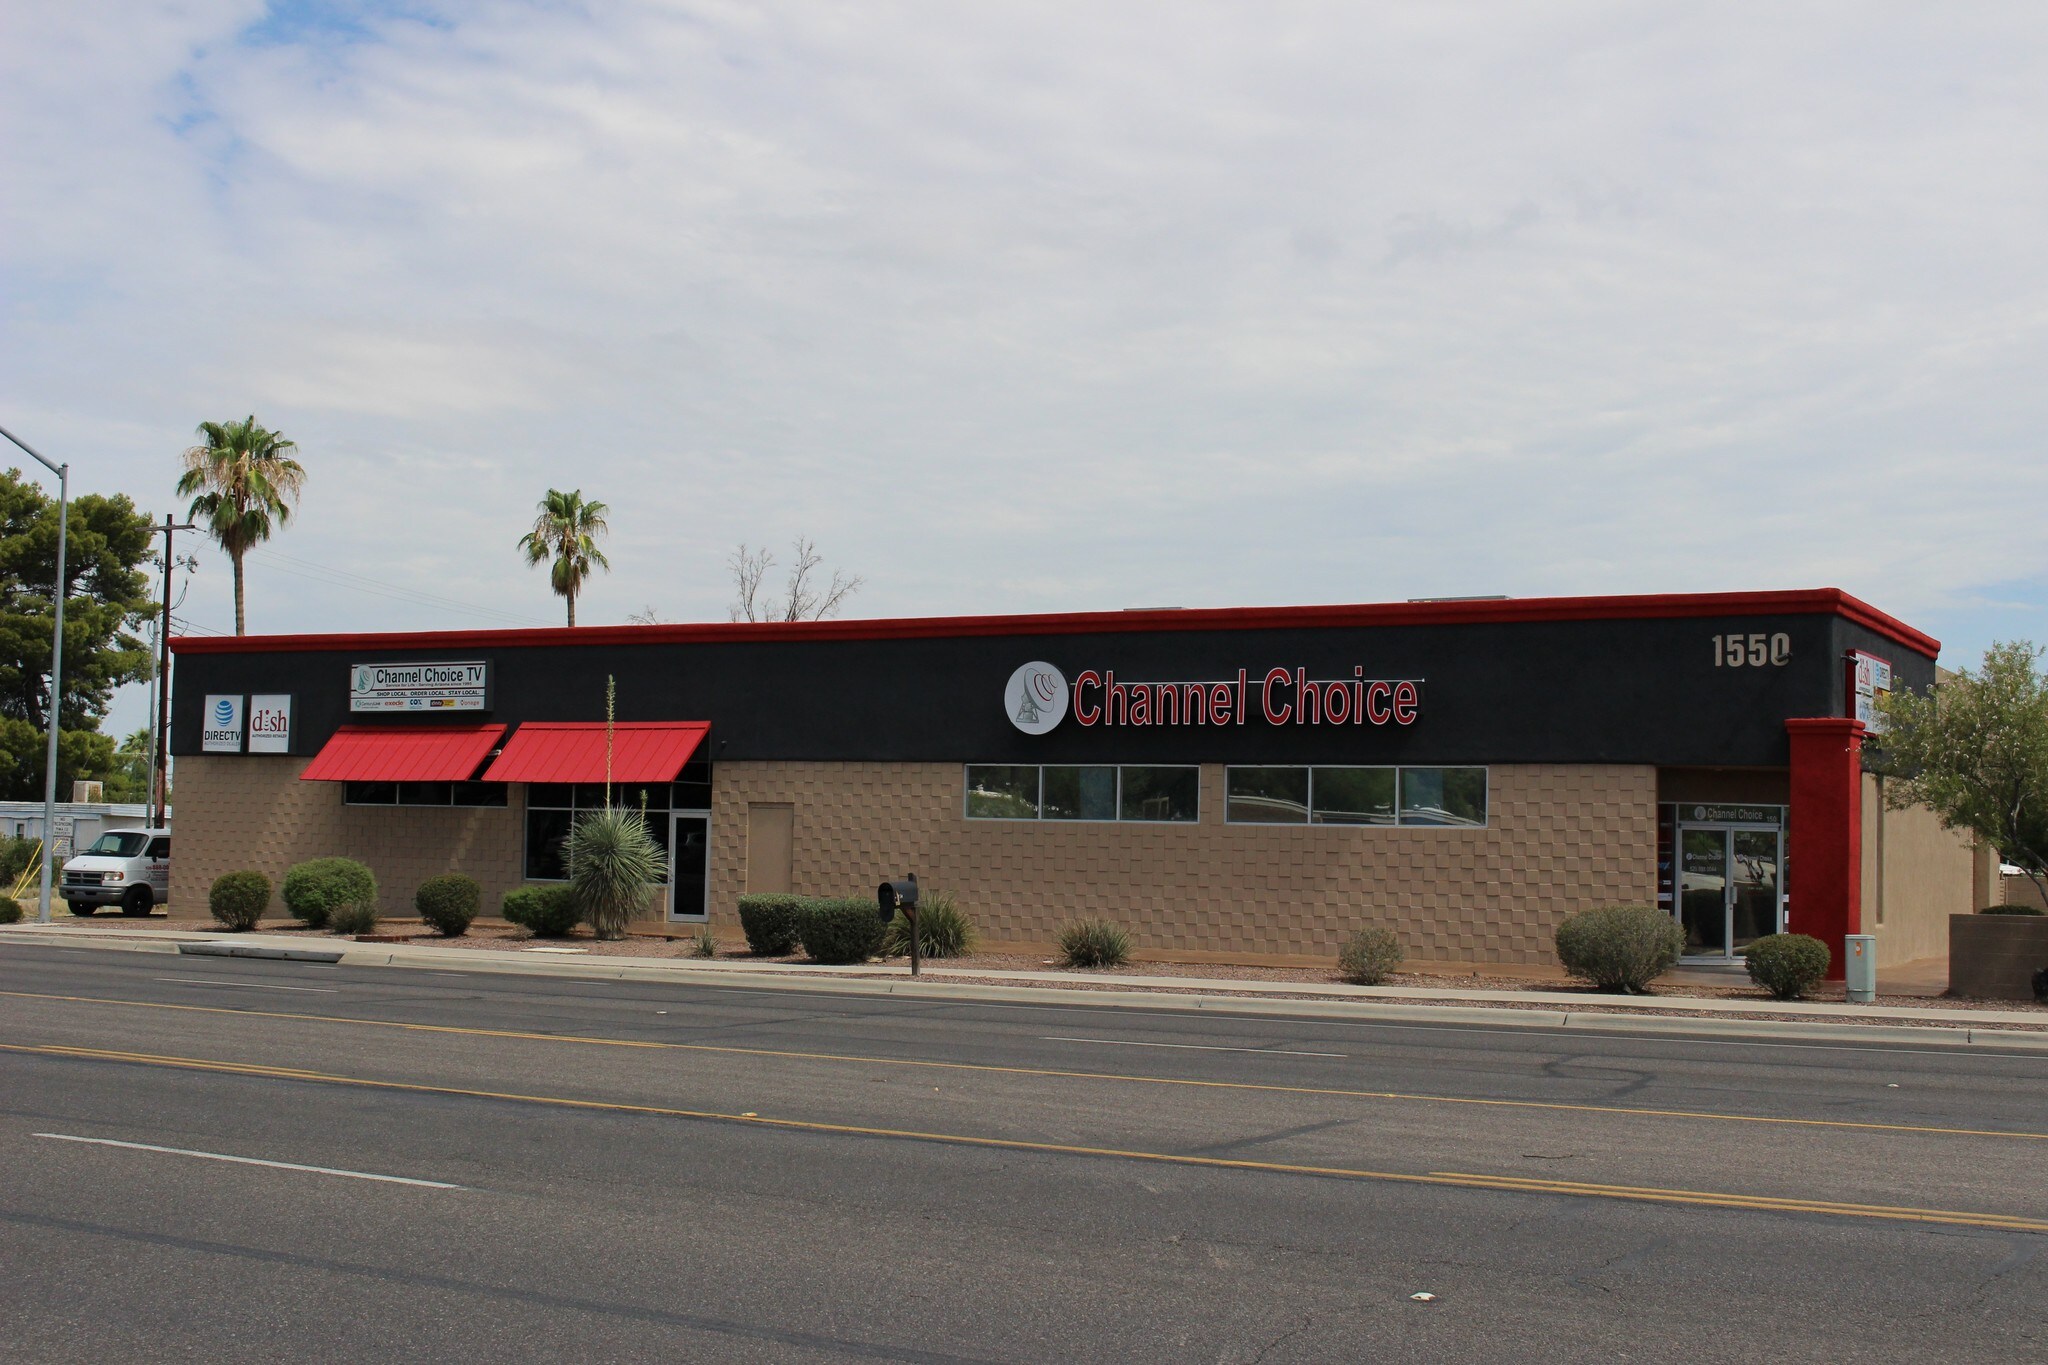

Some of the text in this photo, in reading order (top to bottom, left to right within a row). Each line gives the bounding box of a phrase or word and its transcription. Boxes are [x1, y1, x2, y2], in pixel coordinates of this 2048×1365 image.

[1711, 632, 1790, 667] 1550
[376, 666, 482, 683] Channel Choice TV
[1073, 665, 1418, 726] Channel Choice
[252, 709, 287, 732] dish
[204, 731, 241, 740] DIRECTV
[1707, 807, 1763, 820] Channel Choice
